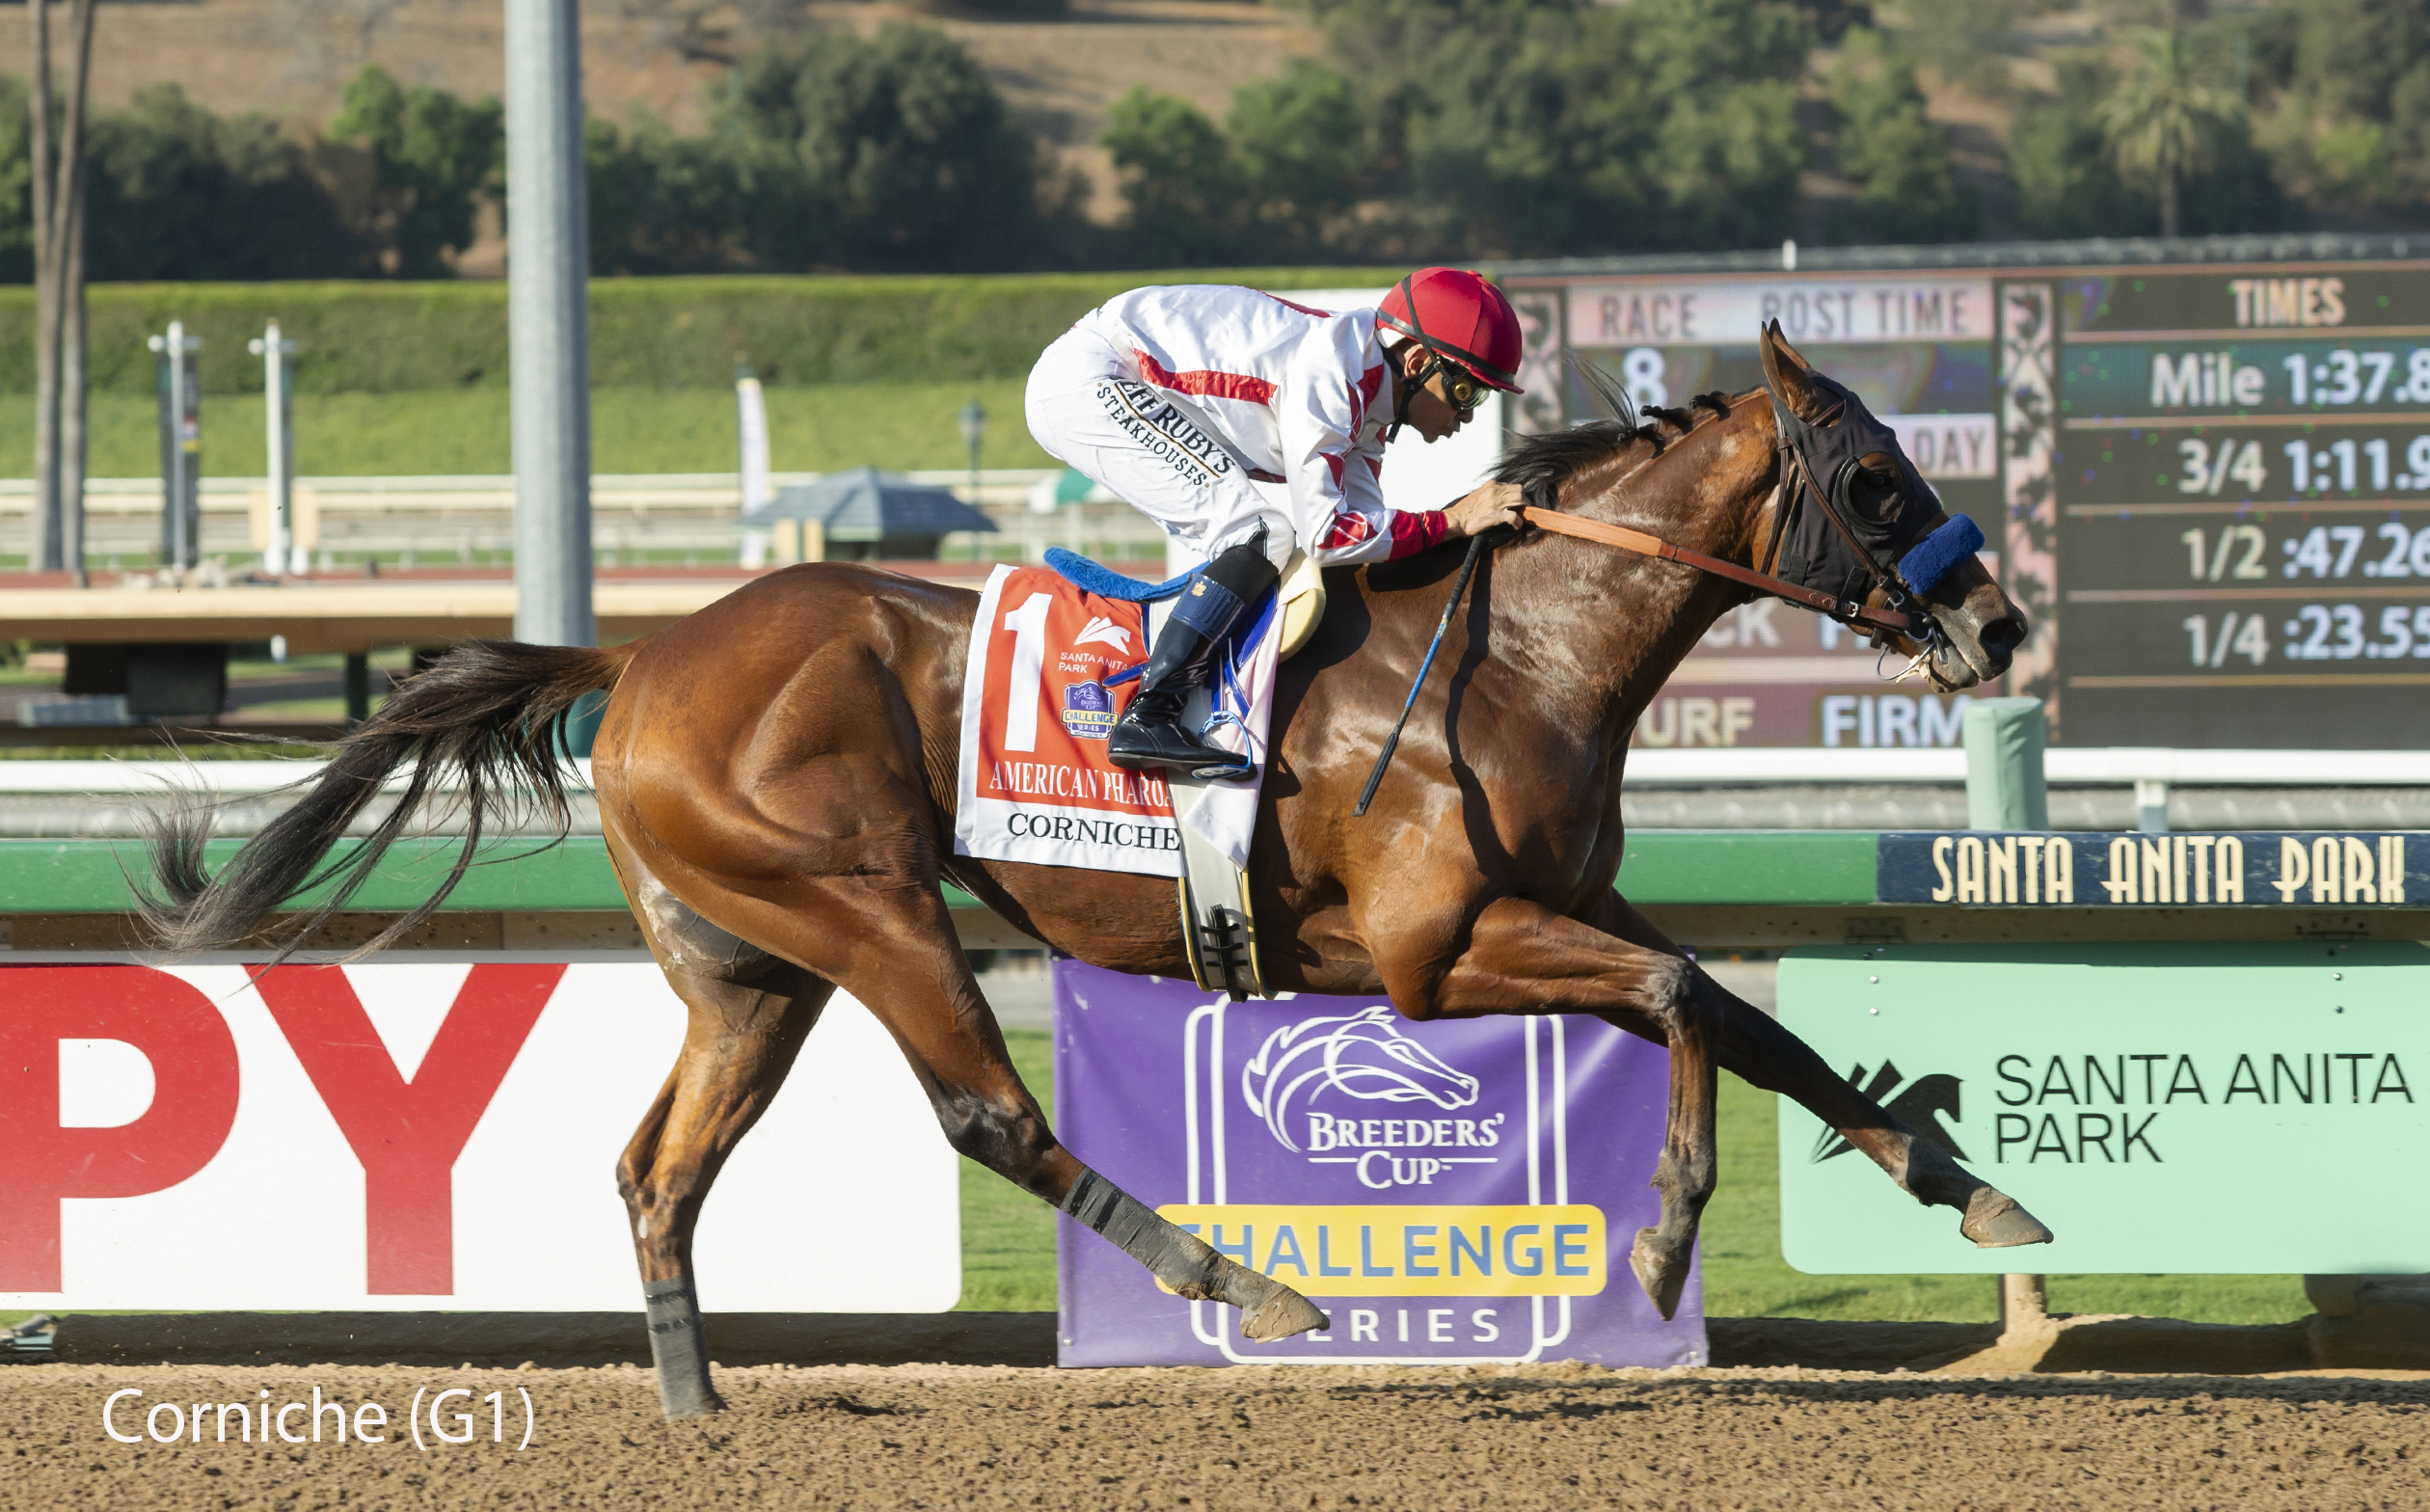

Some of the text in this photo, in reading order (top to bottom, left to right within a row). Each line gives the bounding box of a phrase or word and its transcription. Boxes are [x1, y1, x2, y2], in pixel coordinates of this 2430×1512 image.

[1600, 293, 1699, 338] RACE
[1762, 289, 1969, 336] POST TIME
[2231, 278, 2346, 326] TIMES
[1623, 347, 1667, 415] 8
[2150, 352, 2265, 408] Mile
[1096, 386, 1207, 486] STEAKHOUSES
[1117, 380, 1235, 473] EFF RUBY'S
[1913, 426, 1987, 470] DAY
[2176, 437, 2268, 496] 3/4
[2181, 525, 2267, 582] 1/2
[1060, 651, 1128, 671] SANTA ANITA
[2183, 611, 2270, 669] 1/4
[1004, 592, 1053, 753] 1
[1058, 662, 1089, 674] PARK
[1065, 711, 1116, 724] CHALLENGE
[1077, 723, 1100, 732] SERIES
[1639, 693, 1973, 748] URF FIRM
[988, 760, 1174, 808] AMERICAN PHAROA
[1007, 812, 1181, 851] CORNICHE
[1931, 835, 2405, 904] SANTA ANITA PARK
[1994, 1052, 2416, 1106] SANTA ANITA
[1306, 1112, 1505, 1151] BREEDERS'
[1994, 1112, 2165, 1163] PARK
[1356, 1149, 1442, 1190] CUP
[1178, 1223, 1591, 1278] HALLENGE
[1271, 1308, 1501, 1343] ERIES
